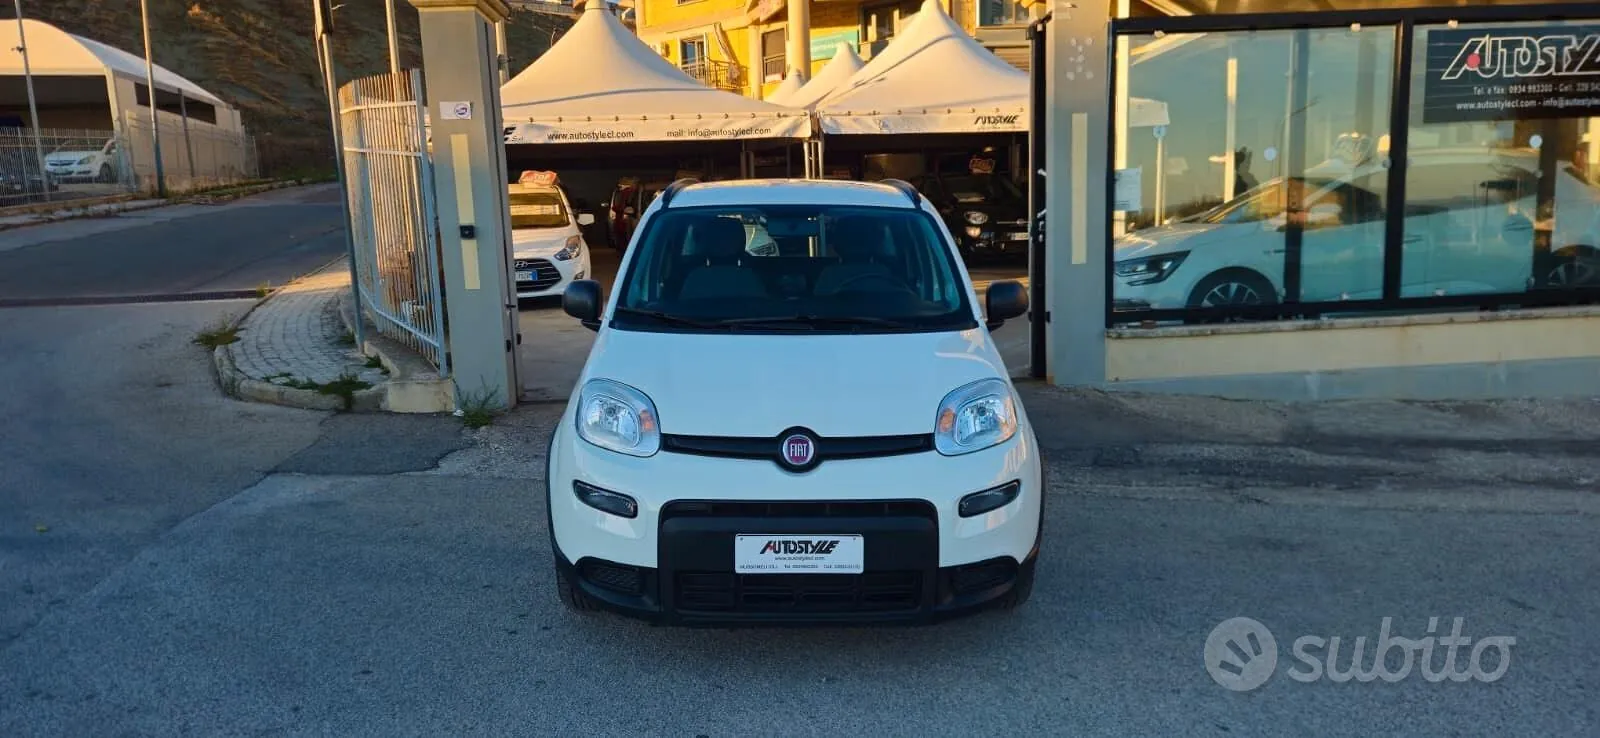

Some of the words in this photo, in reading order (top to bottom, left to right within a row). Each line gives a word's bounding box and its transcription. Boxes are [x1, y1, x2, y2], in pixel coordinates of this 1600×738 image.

[547, 130, 634, 140] www.autostylecl.com
[688, 127, 771, 138] info@autostylecl.com
[790, 443, 808, 457] FIAT
[760, 540, 840, 554] AUTOSTYLE
